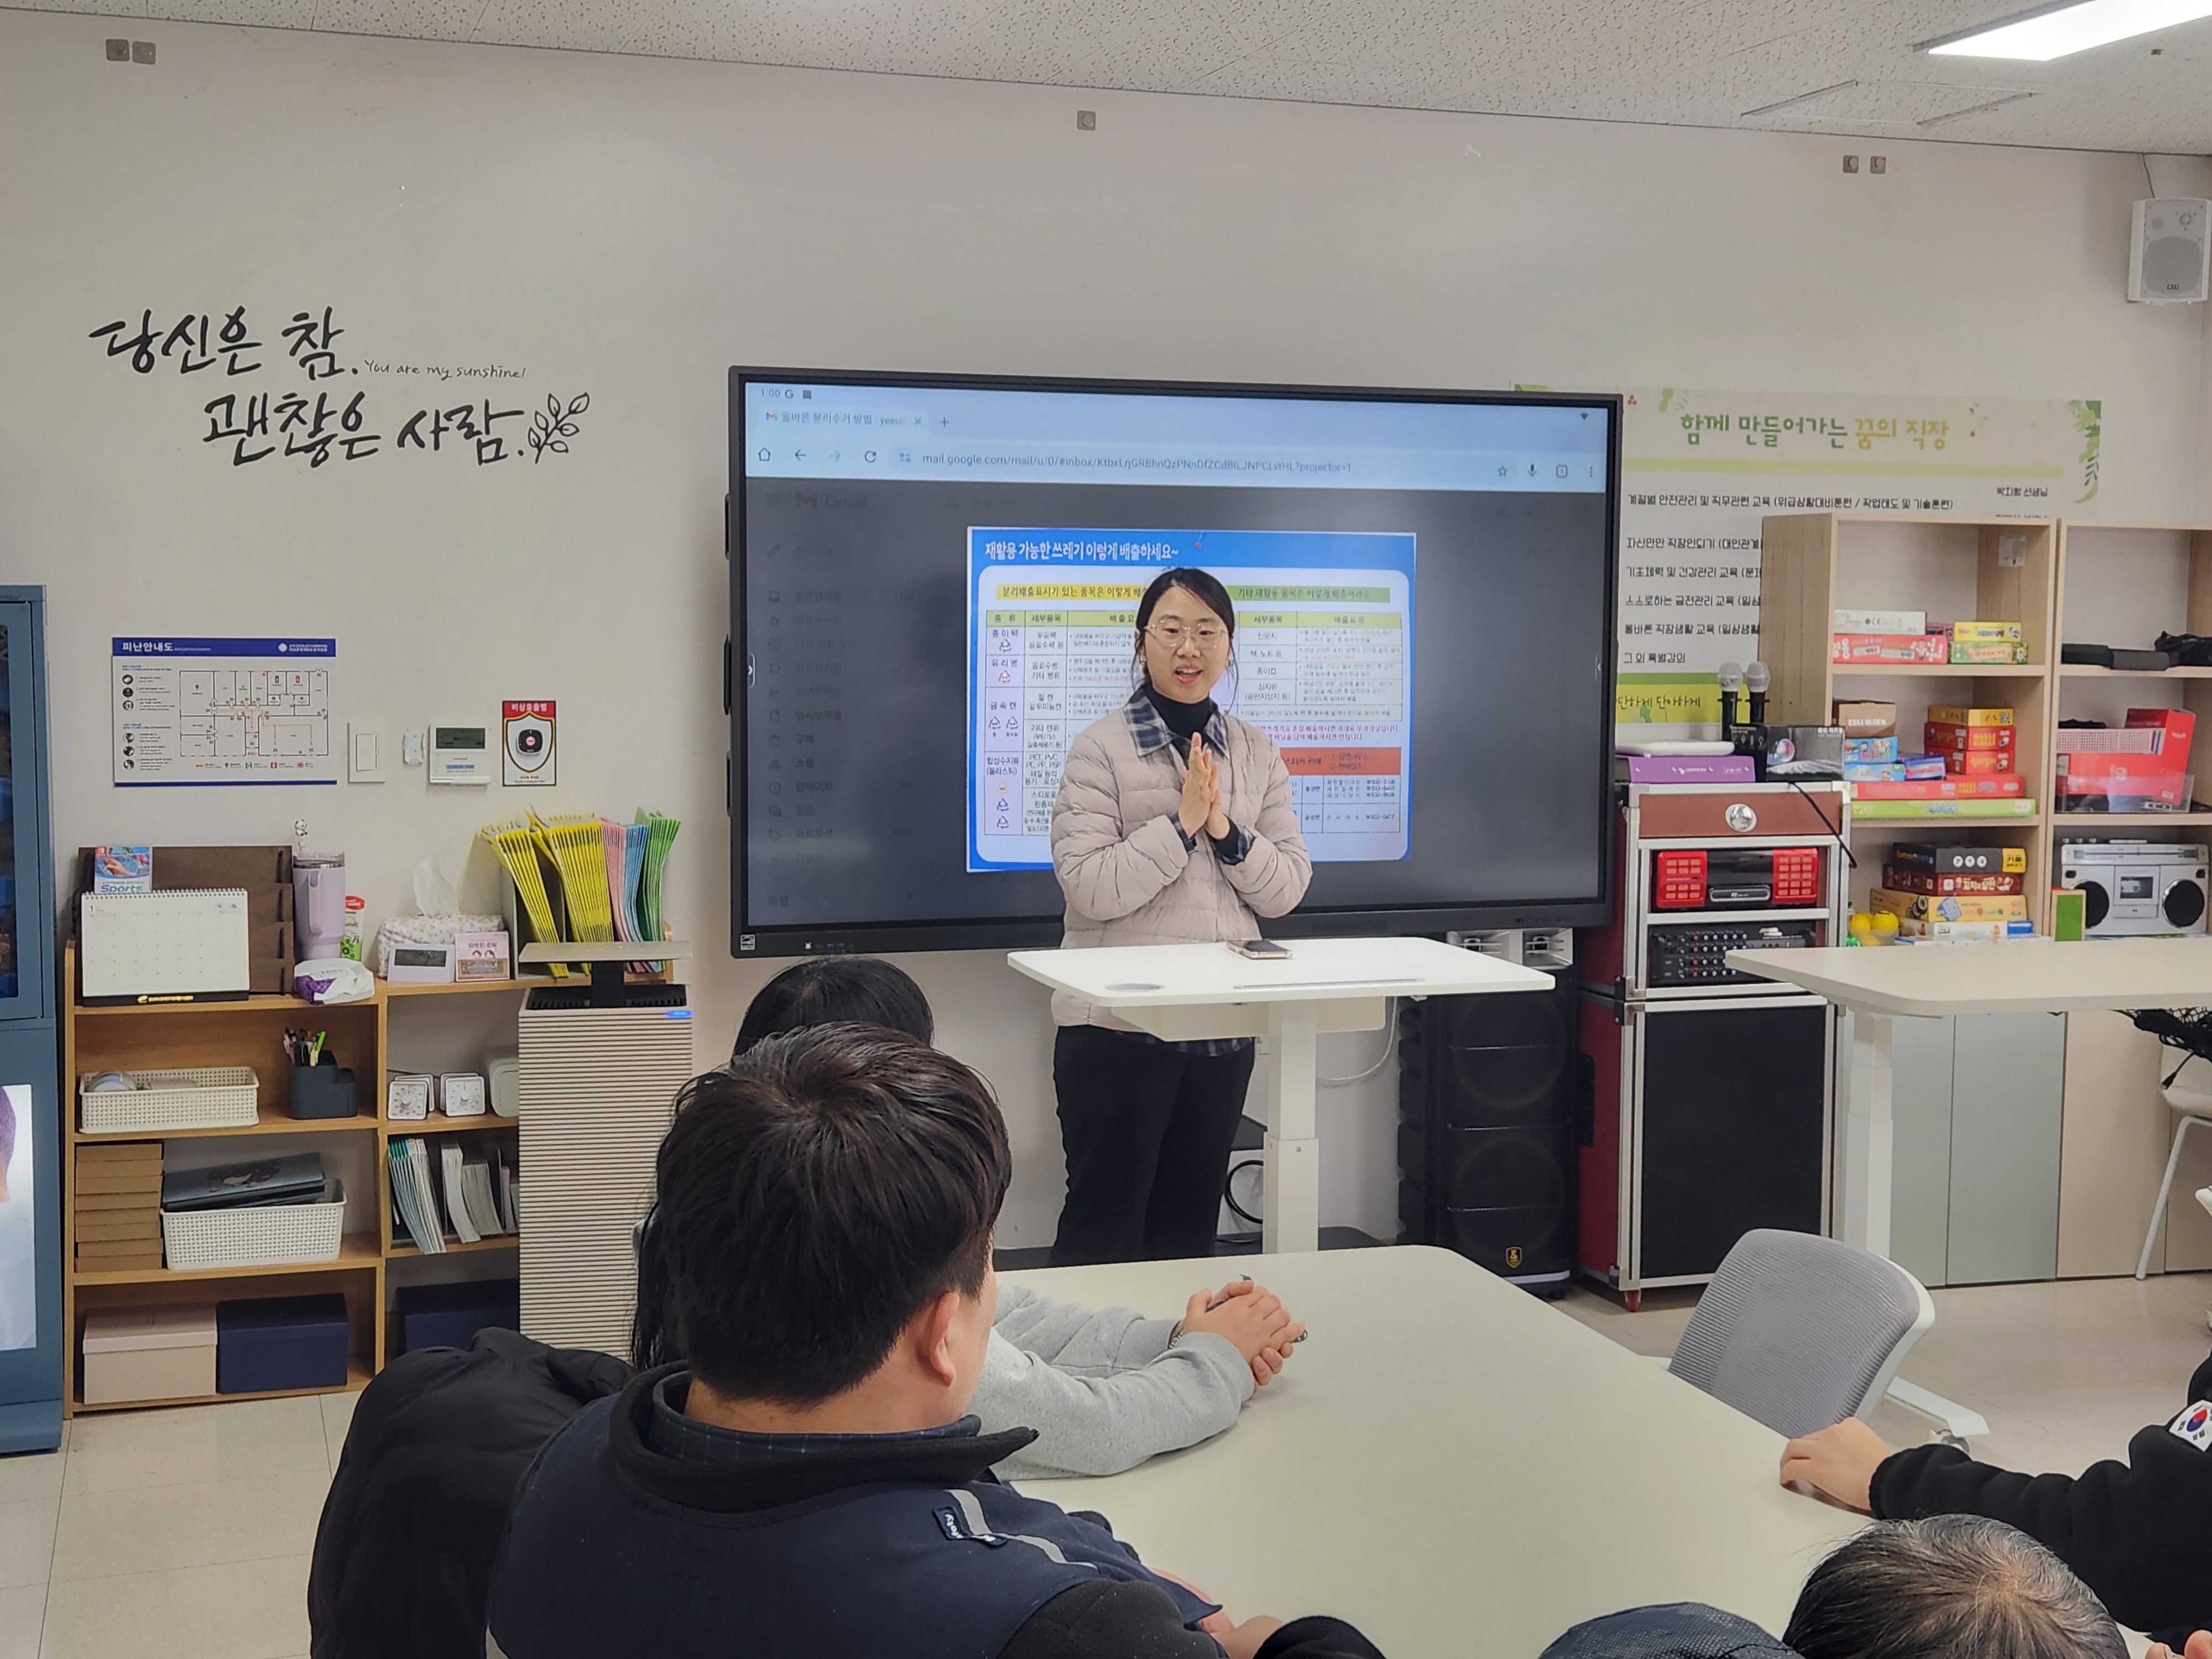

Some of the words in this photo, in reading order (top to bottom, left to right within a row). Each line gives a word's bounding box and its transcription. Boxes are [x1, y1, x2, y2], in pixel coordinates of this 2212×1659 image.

[88, 305, 263, 375] 당신은
[281, 306, 359, 380] 참.
[364, 358, 390, 375] You
[396, 363, 420, 376] are
[426, 365, 452, 381] my
[456, 363, 526, 380] sunshine!
[201, 390, 382, 468] 괜찮은
[397, 398, 526, 467] 사람.
[1681, 414, 1730, 445] 함께
[1738, 415, 1848, 448] 만들어가는
[1855, 418, 1897, 450] 꿈의
[1906, 420, 1950, 450] 직장
[1659, 494, 1697, 506] 안전관리
[1700, 495, 1709, 506] 및
[1712, 495, 1750, 507] 직무관련
[1752, 496, 1771, 507] 교육
[1863, 498, 1899, 509] 작업태도
[1902, 498, 1911, 509] 및
[1627, 537, 1665, 549] 자신만만
[1667, 538, 1715, 550] 직장인되기
[985, 541, 1018, 560] 재활용
[1019, 540, 1051, 560] 가능한
[1052, 541, 1084, 560] 쓰레기
[1086, 542, 1117, 561] 이렇게
[1119, 542, 1179, 561] 배출하세요~
[1626, 566, 1665, 577] 기초체력
[1667, 566, 1676, 577] 및
[1679, 567, 1717, 577] 건강관리
[1719, 567, 1738, 578] 교육
[1062, 587, 1077, 597] 있는
[1107, 587, 1131, 598] 이렇게
[1625, 595, 1672, 606] 스스로하는
[1676, 596, 1713, 607] 금전관리
[1716, 596, 1734, 606] 교육
[1625, 623, 1653, 634] 올바른
[1655, 624, 1694, 635] 직장생활
[1696, 624, 1715, 635] 교육
[122, 641, 174, 653] 피난안내도
[101, 884, 144, 894] Sports
